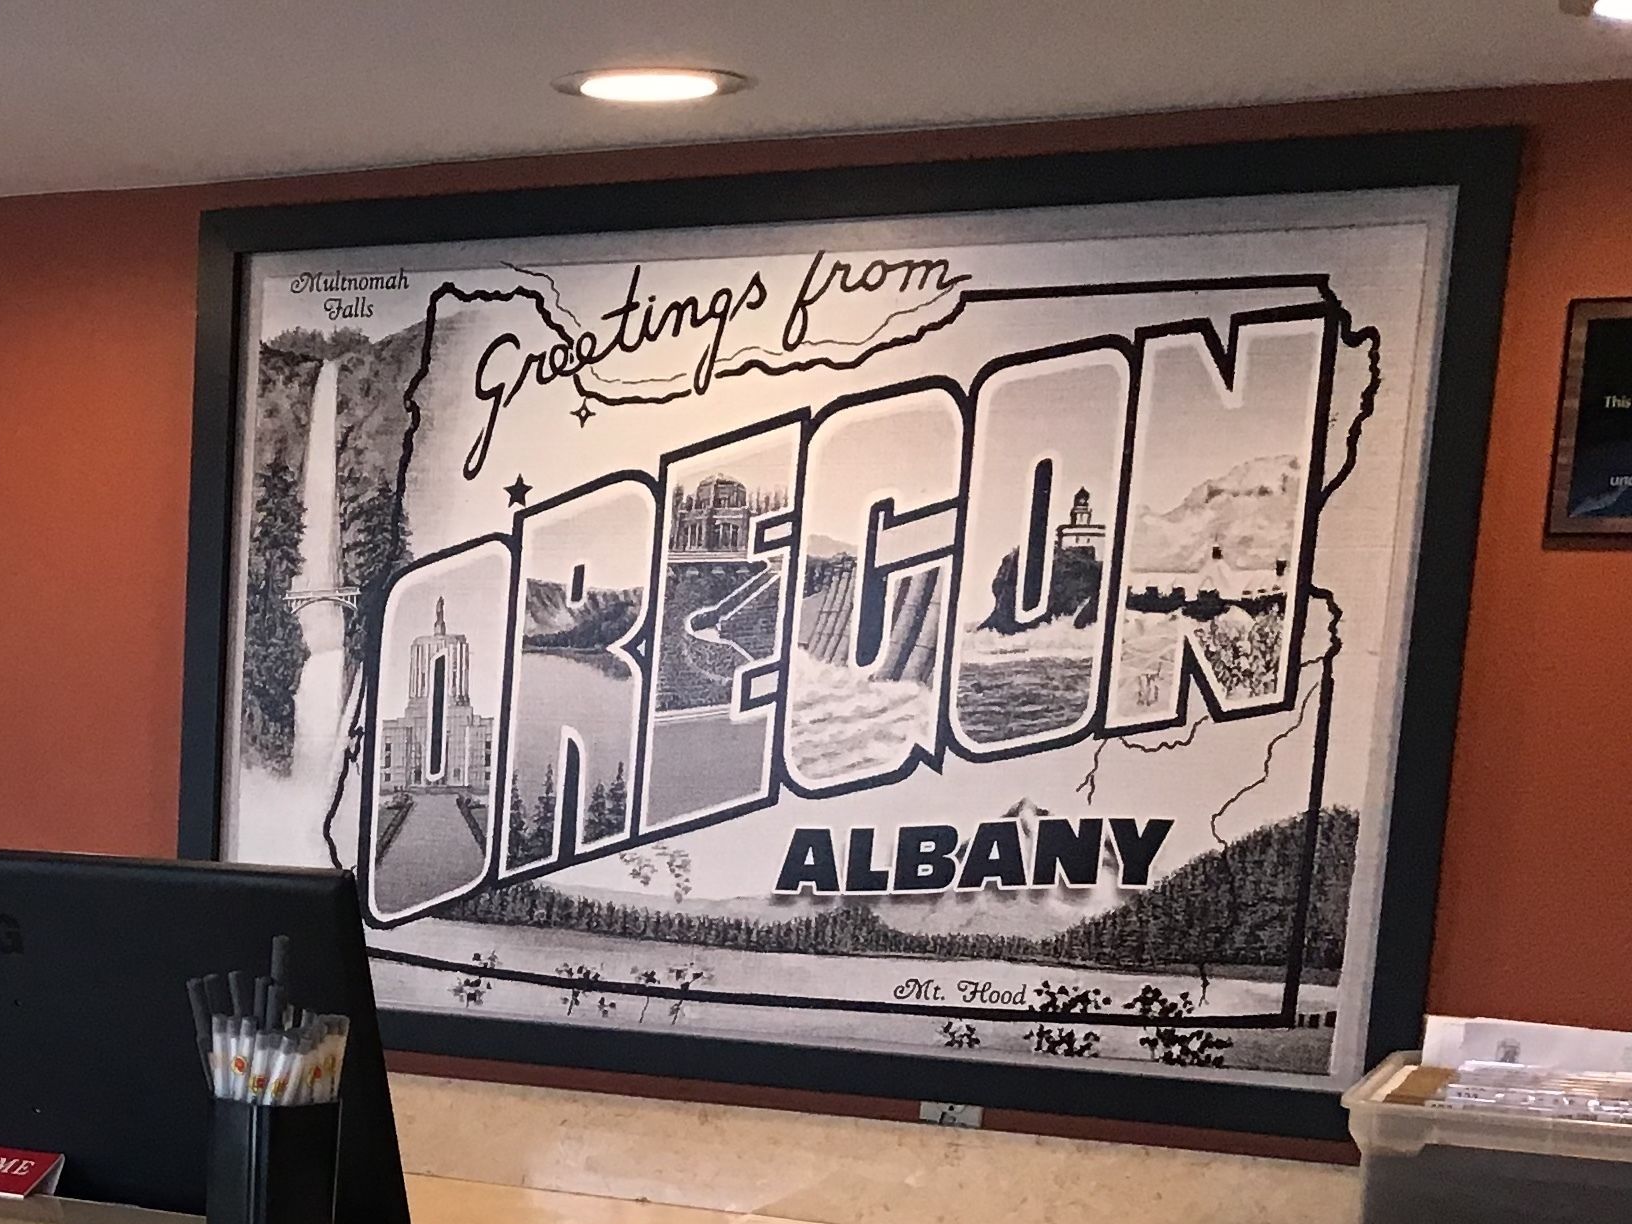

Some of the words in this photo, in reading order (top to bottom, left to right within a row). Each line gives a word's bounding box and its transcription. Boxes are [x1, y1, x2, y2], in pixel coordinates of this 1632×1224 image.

[290, 267, 410, 293] Multnomah
[323, 296, 374, 321] Falls
[463, 265, 767, 481] Greetings
[783, 250, 972, 351] from
[360, 302, 1336, 930] OREGON
[774, 817, 1176, 895] ALBANY
[893, 978, 946, 1001] Mt.
[956, 980, 1027, 1005] Hood
